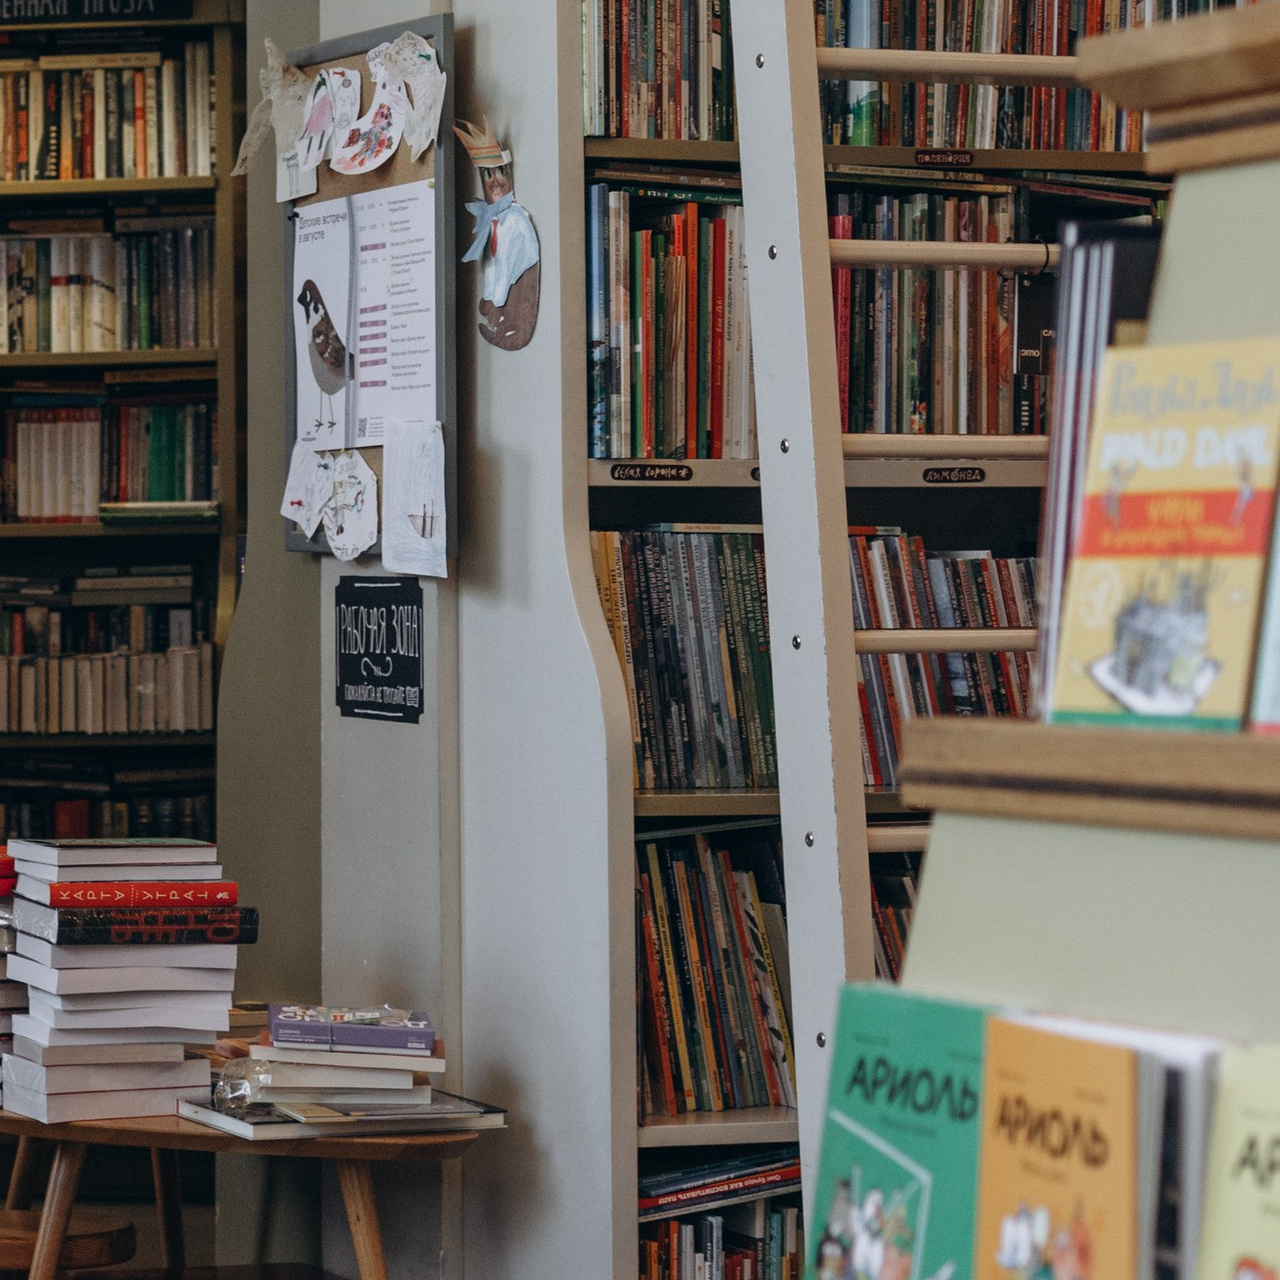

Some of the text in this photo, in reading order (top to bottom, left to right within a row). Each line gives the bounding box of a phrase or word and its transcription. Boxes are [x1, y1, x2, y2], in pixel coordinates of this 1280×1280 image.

[322, 211, 347, 225] встречи
[304, 230, 325, 246] августе
[1021, 350, 1040, 358] это
[614, 547, 622, 578] МАЛЫШ
[617, 580, 626, 607] ИМЕНИ
[341, 604, 418, 657] РАБОЧАЯ ЗОНА
[621, 623, 632, 664] ПАРУСНИК
[60, 890, 208, 901] КАРТА УТРАТ
[847, 1055, 978, 1124] АРИОЛЬ
[995, 1091, 1111, 1170] АРИОЛЬ
[658, 1196, 677, 1204] ПАПУ
[678, 1184, 728, 1199] ВОСПИТЫВАТЬ
